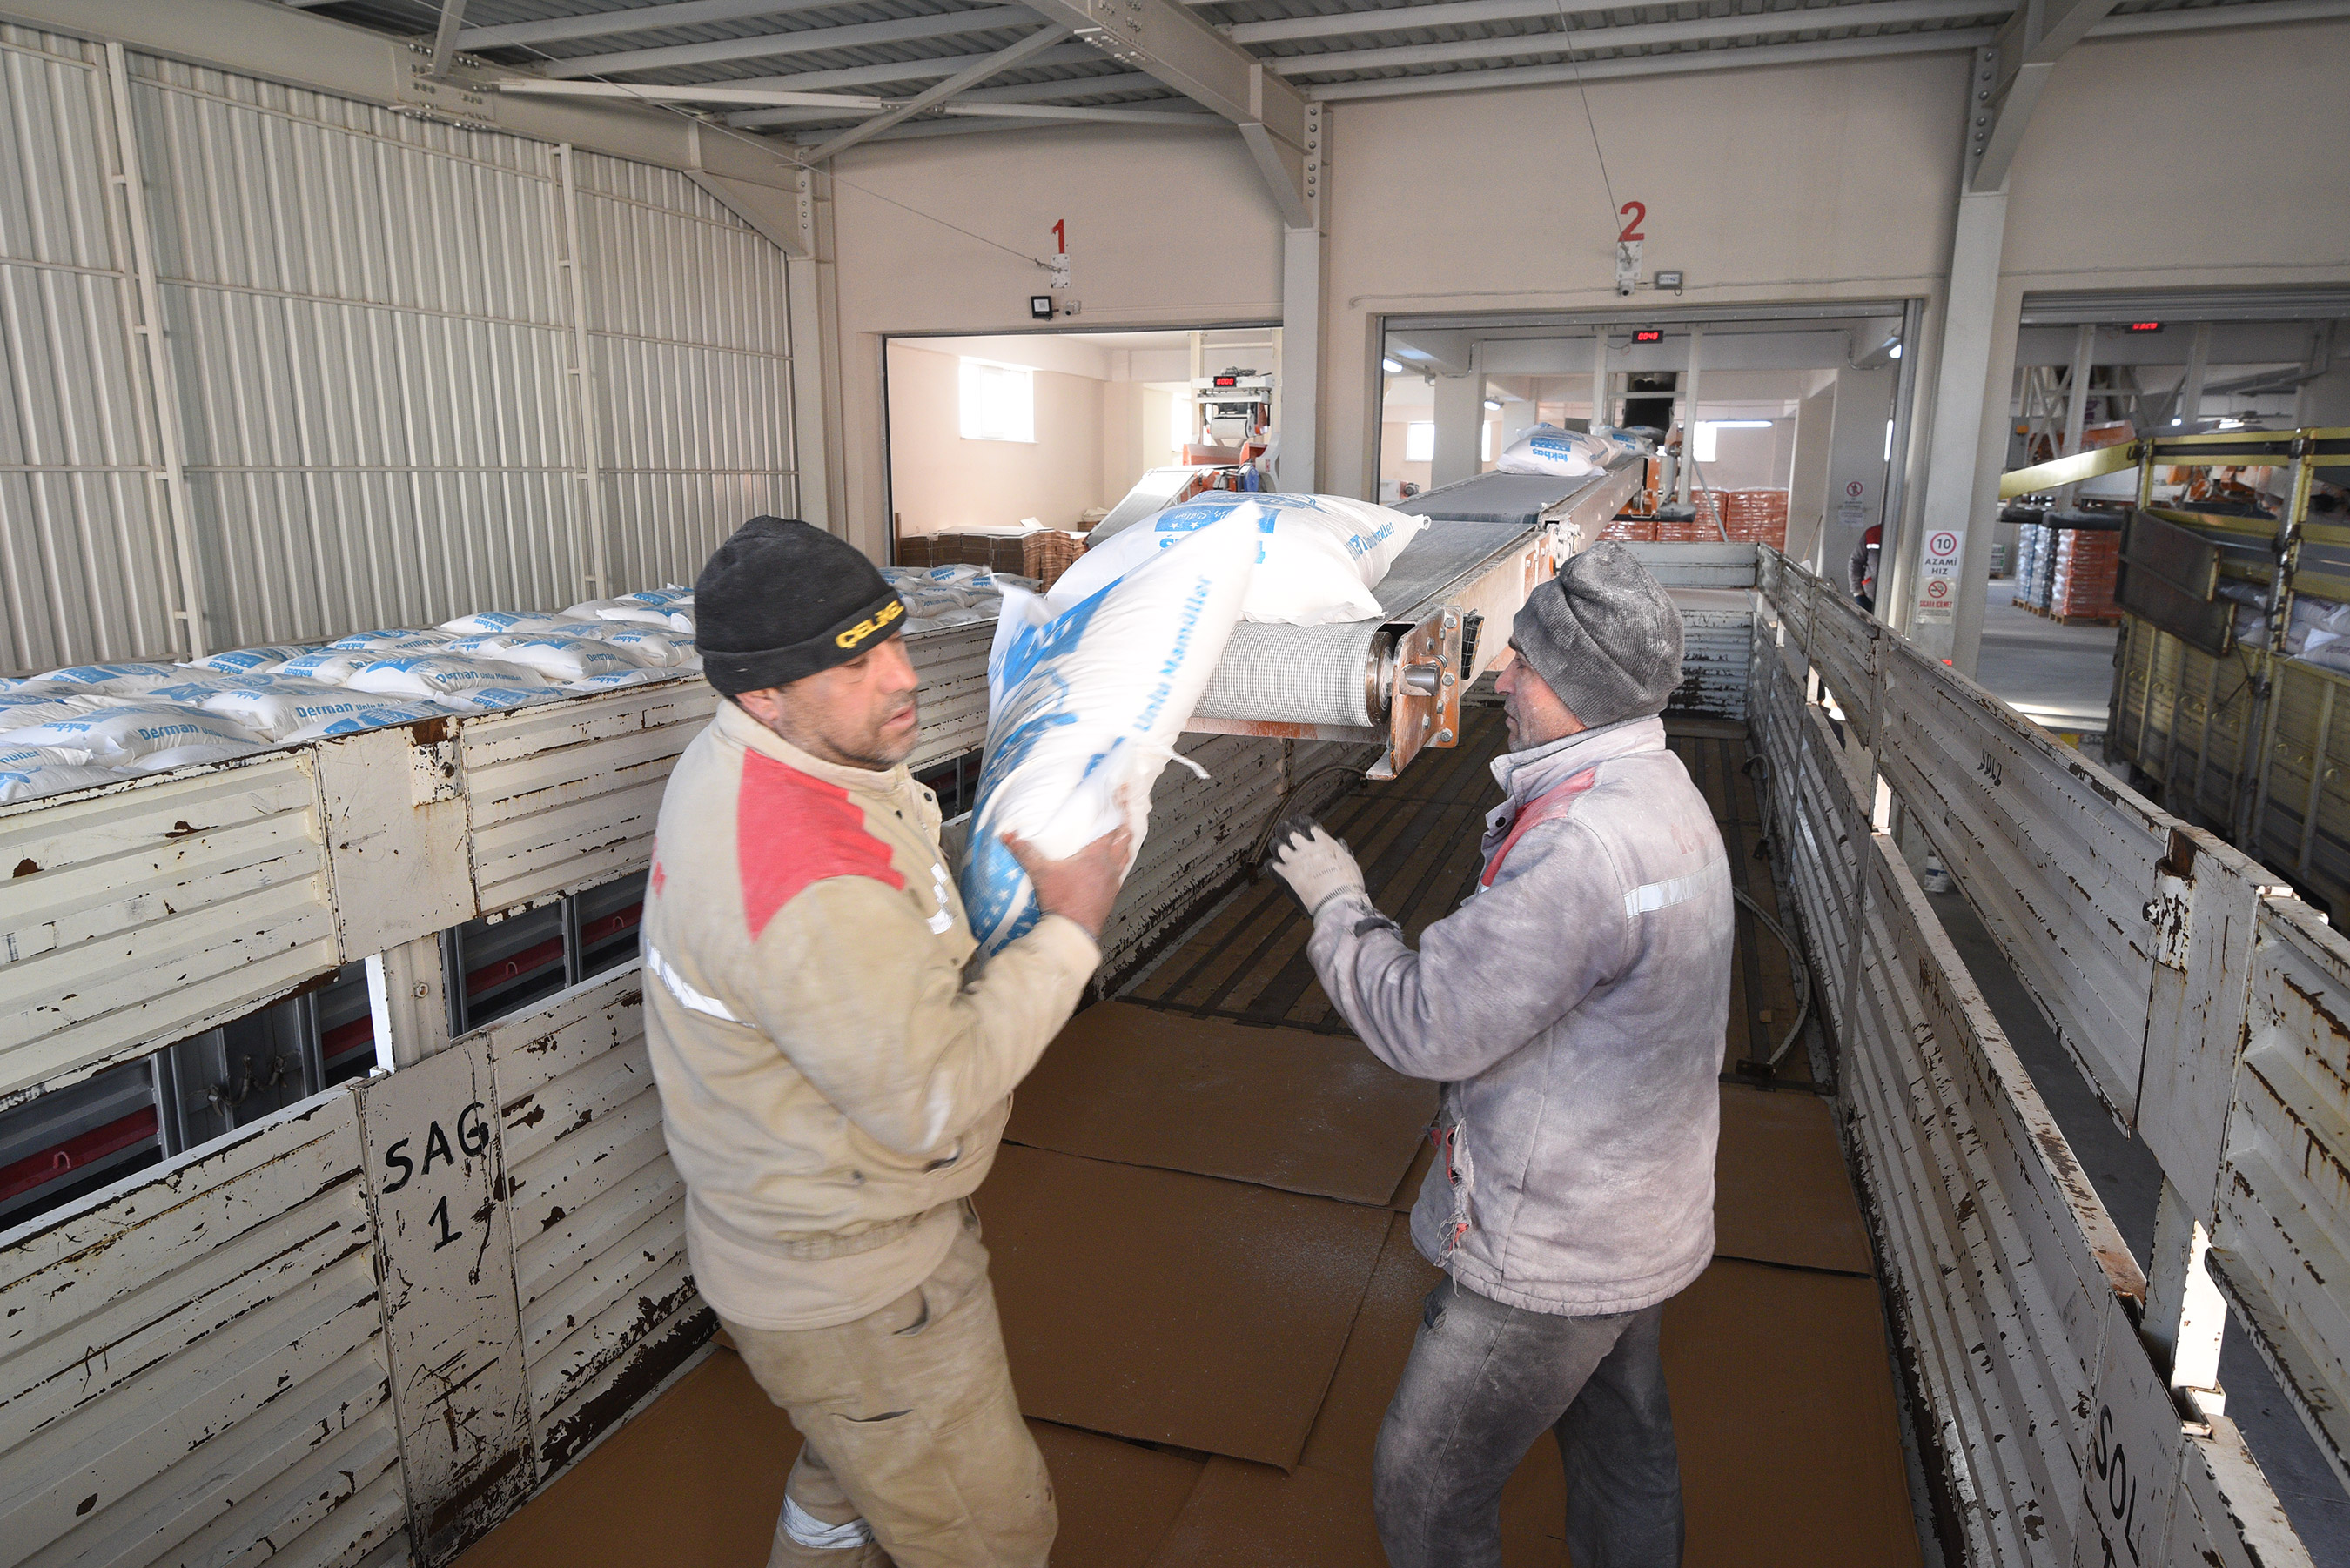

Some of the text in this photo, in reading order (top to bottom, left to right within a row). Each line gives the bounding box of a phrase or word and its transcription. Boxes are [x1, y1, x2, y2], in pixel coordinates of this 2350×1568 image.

[1618, 201, 1646, 242] 2
[1051, 219, 1064, 254] 1
[1216, 377, 1234, 385] 0000
[1937, 539, 1951, 549] 10
[1924, 557, 1957, 566] AZAMİ
[296, 702, 353, 719] Derman
[138, 723, 199, 741] Derman
[428, 1195, 463, 1253] 1
